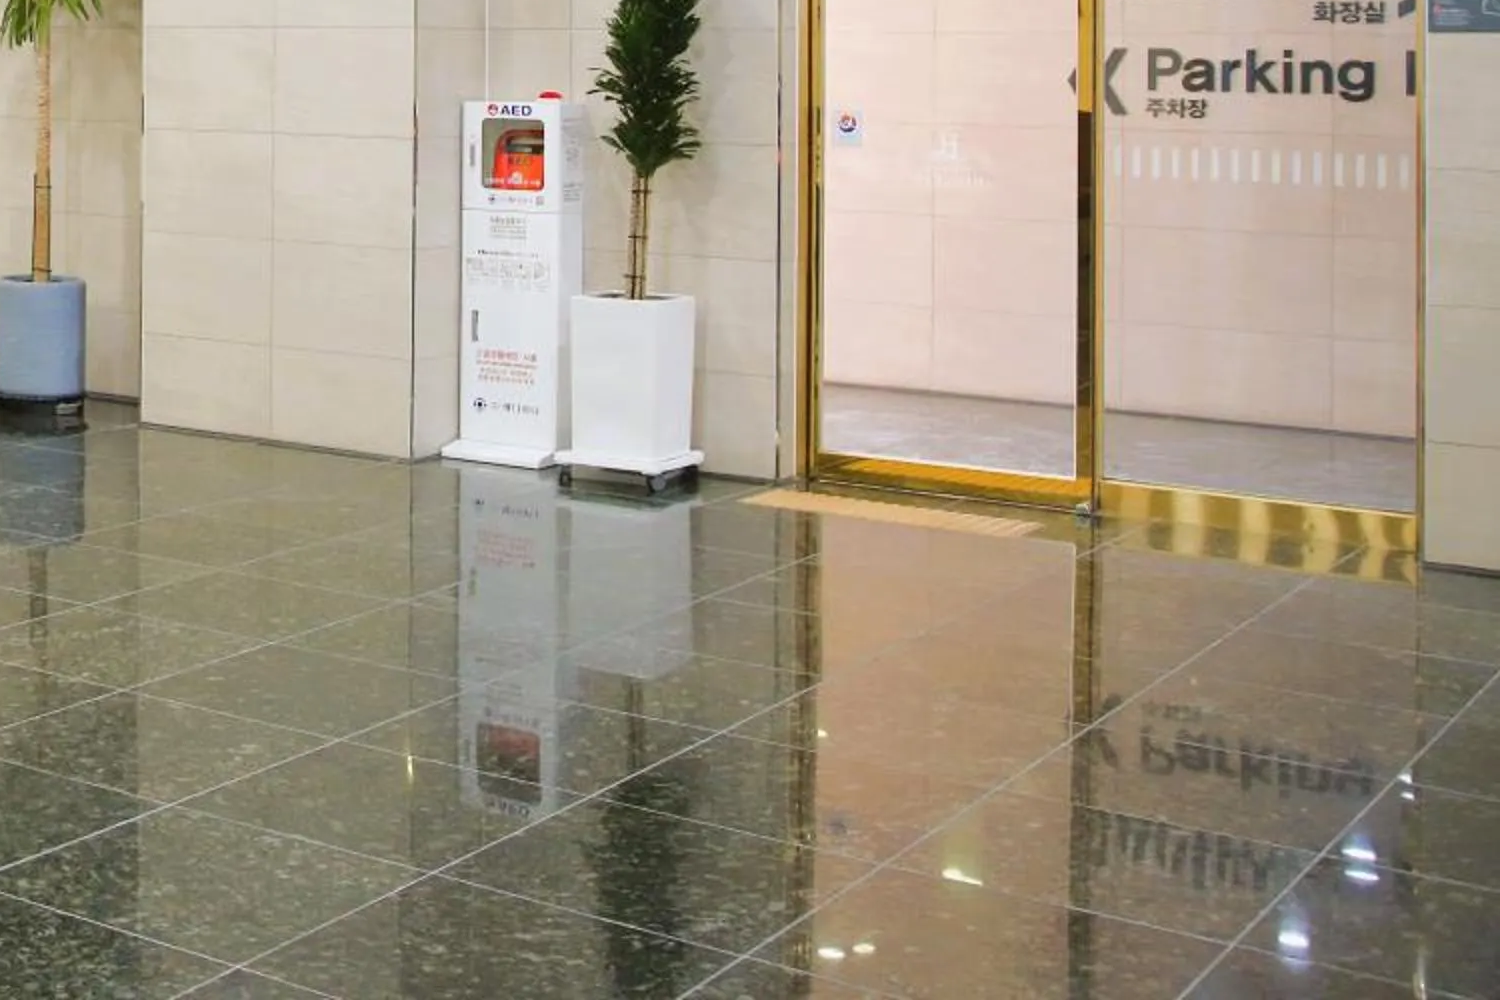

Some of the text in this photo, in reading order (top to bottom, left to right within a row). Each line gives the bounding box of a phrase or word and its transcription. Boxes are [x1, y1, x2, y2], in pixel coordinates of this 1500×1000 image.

[1312, 0, 1387, 25] 화장실
[1147, 48, 1377, 104] Parking
[500, 104, 533, 117] AED
[1146, 99, 1208, 120] 주차장
